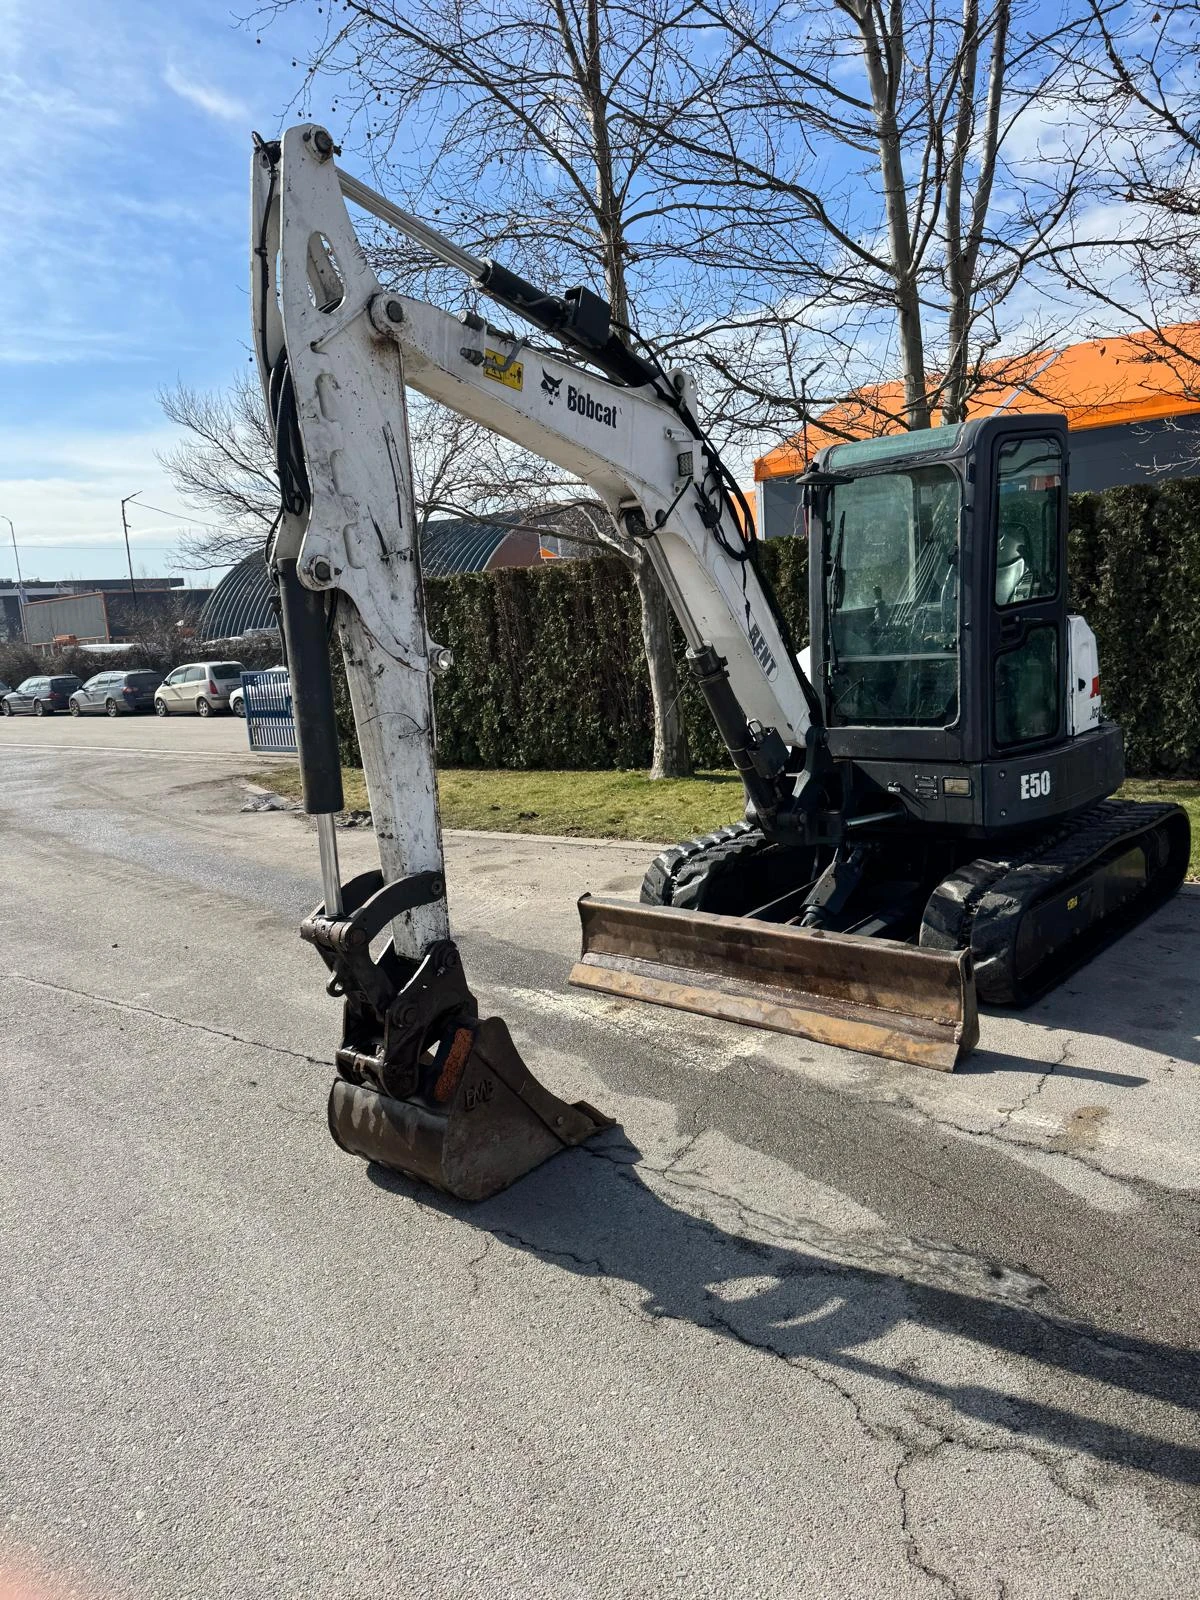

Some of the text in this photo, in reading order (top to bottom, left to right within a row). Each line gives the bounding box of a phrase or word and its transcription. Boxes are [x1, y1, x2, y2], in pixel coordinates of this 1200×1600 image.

[567, 384, 617, 429] Bobcat
[748, 623, 777, 677] RENT
[1020, 770, 1051, 800] E50
